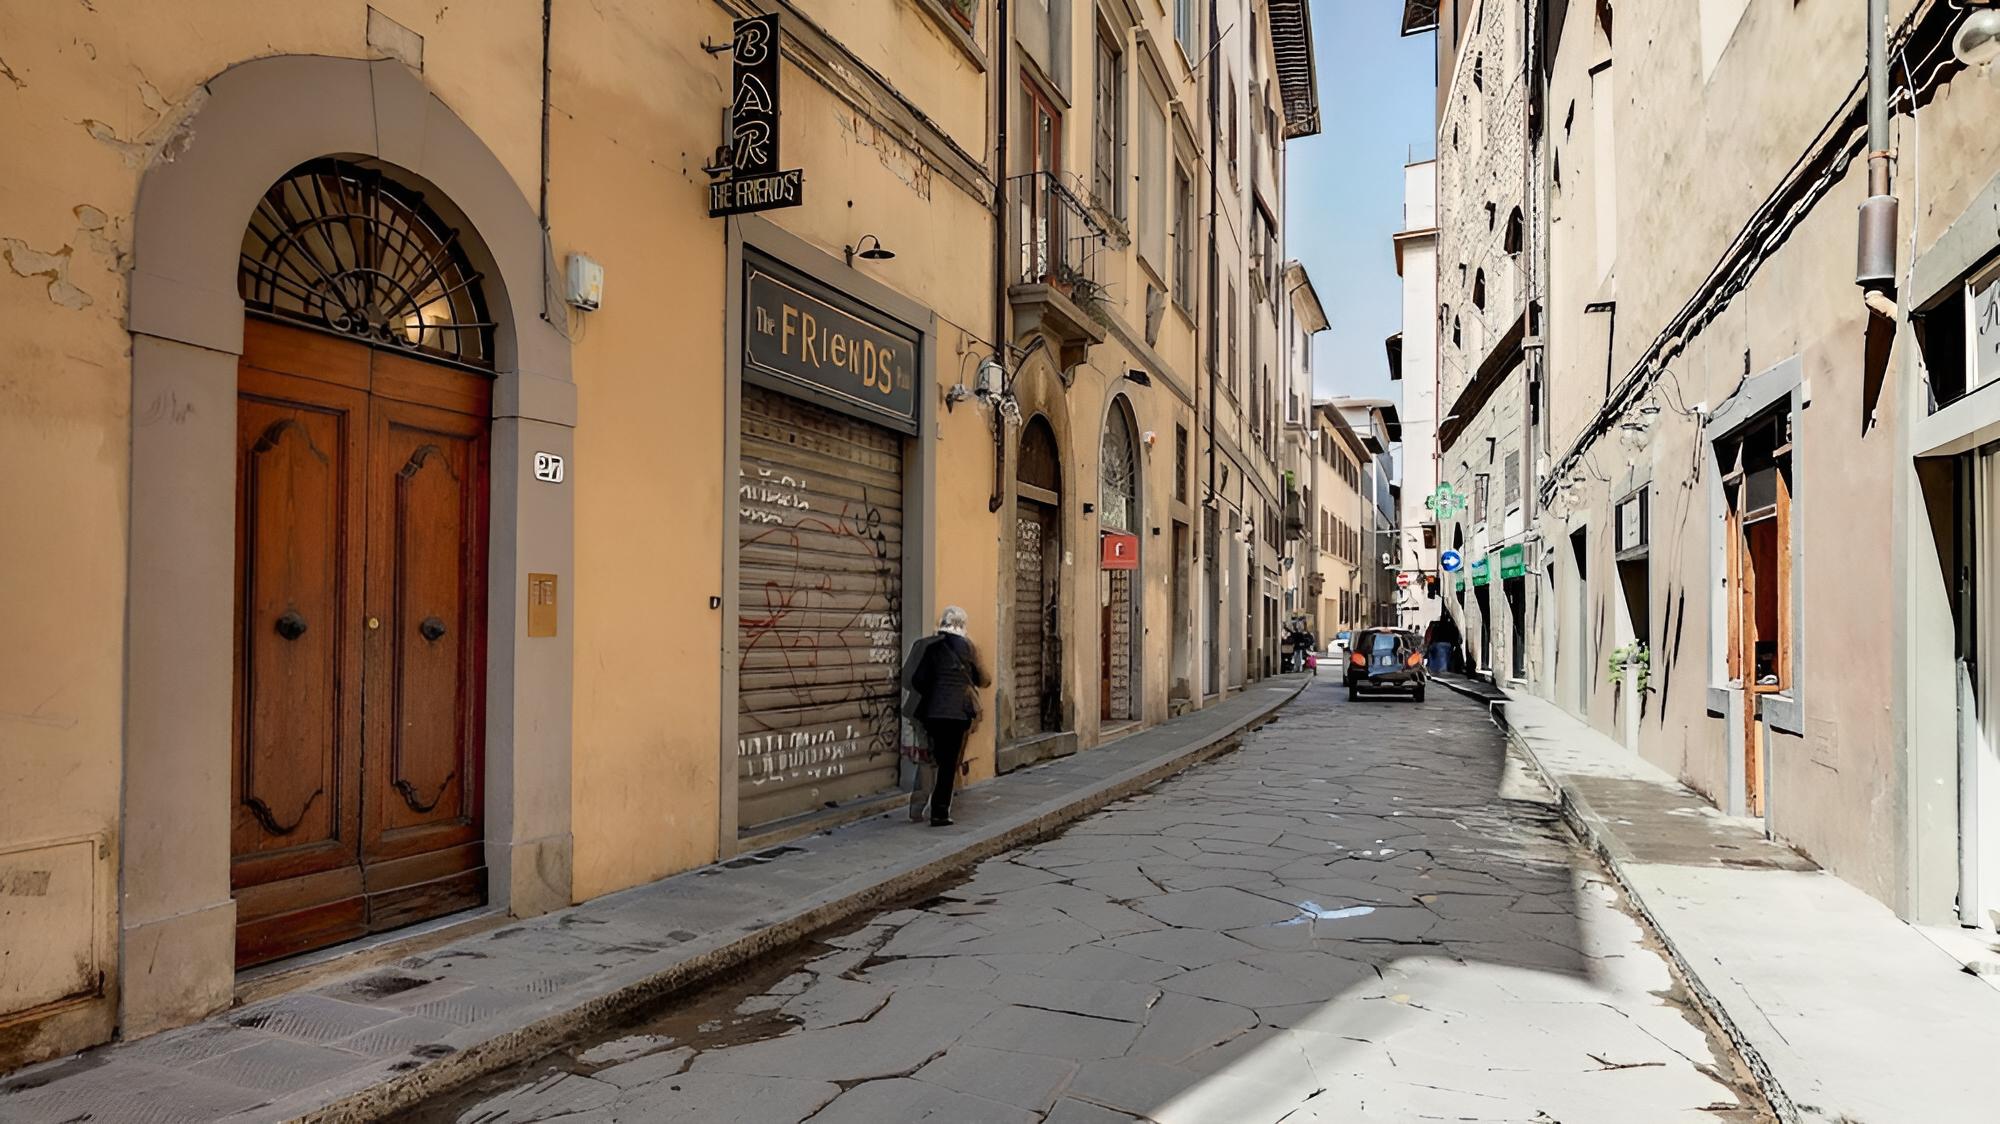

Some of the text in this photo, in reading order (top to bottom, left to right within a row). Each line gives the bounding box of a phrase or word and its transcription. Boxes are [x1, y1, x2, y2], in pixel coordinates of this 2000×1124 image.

[733, 19, 773, 170] BAR
[709, 182, 733, 211] THE
[539, 455, 561, 480] 27
